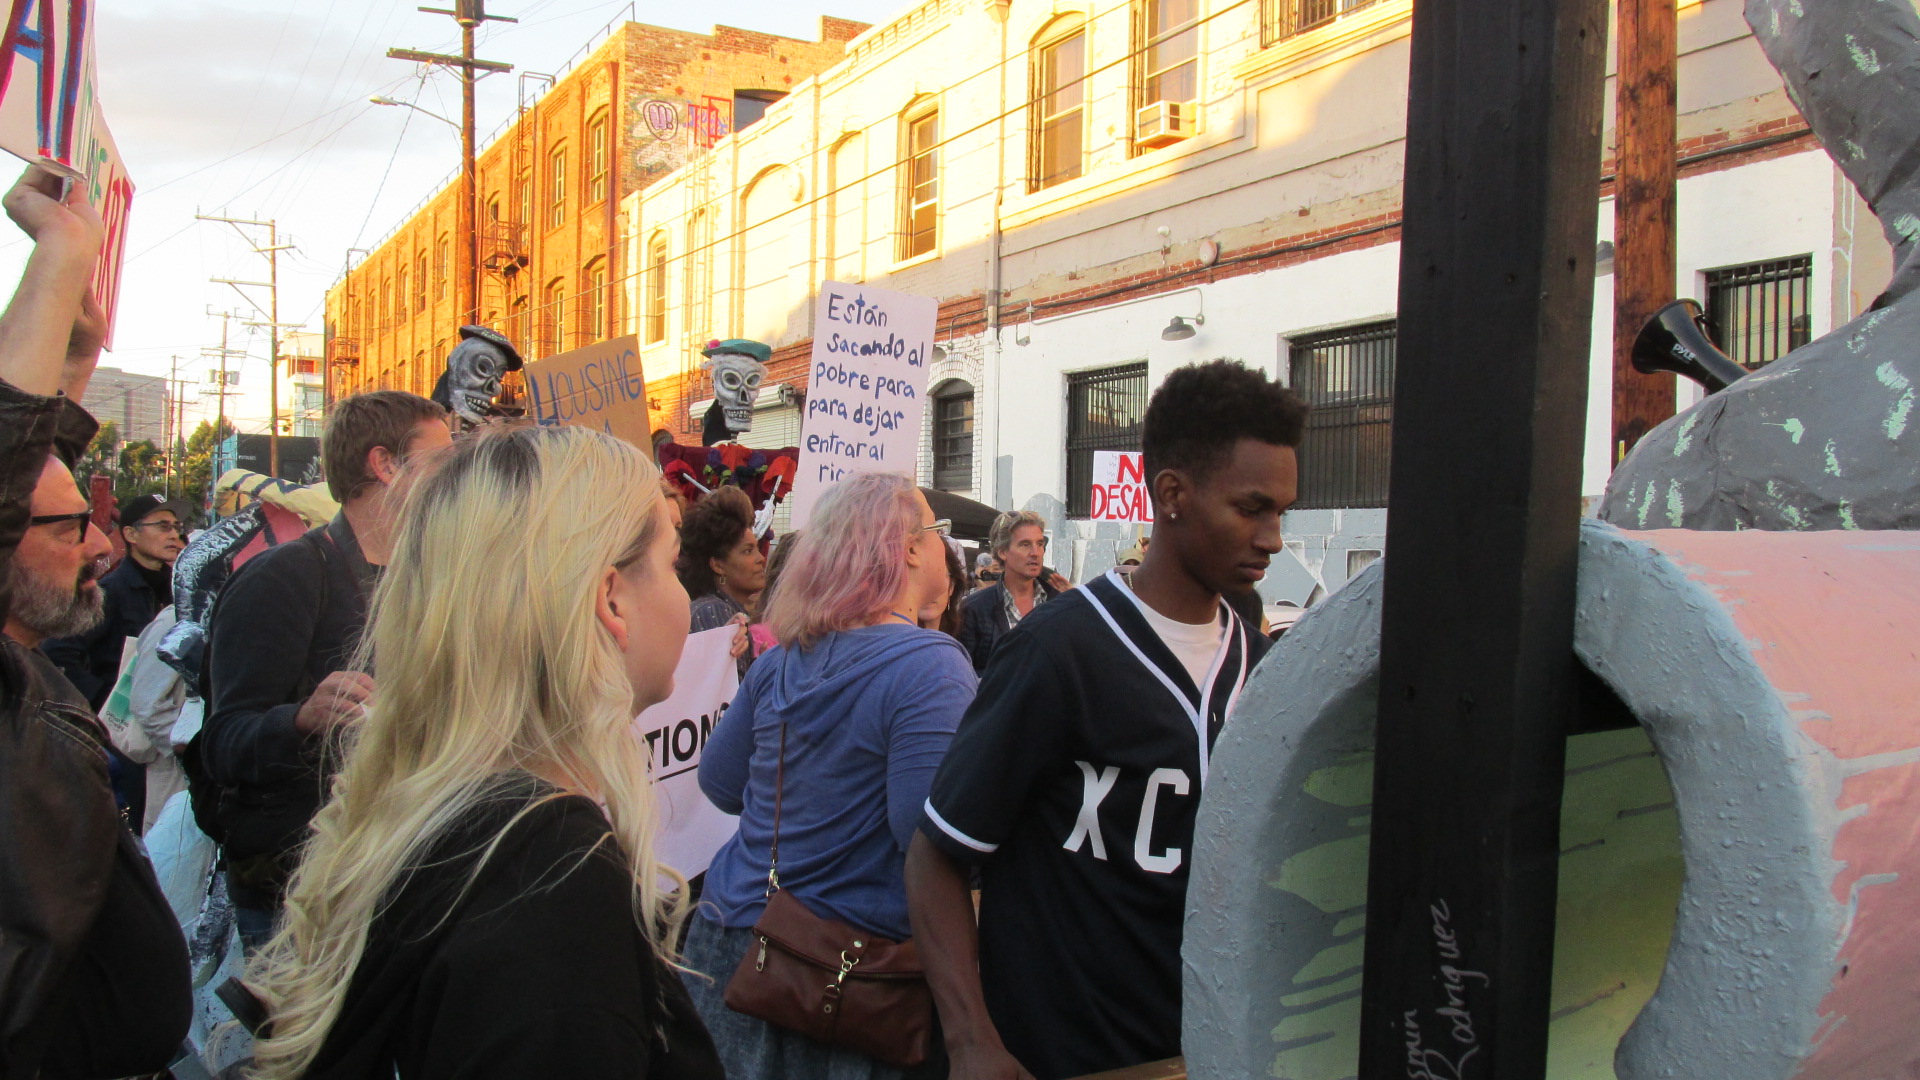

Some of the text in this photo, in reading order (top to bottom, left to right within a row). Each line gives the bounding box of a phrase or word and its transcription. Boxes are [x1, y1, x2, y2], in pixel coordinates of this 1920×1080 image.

[827, 292, 888, 327] Están
[908, 341, 925, 368] al
[530, 349, 642, 427] HOUSING
[816, 361, 915, 400] pobre para
[809, 398, 905, 437] para dejar
